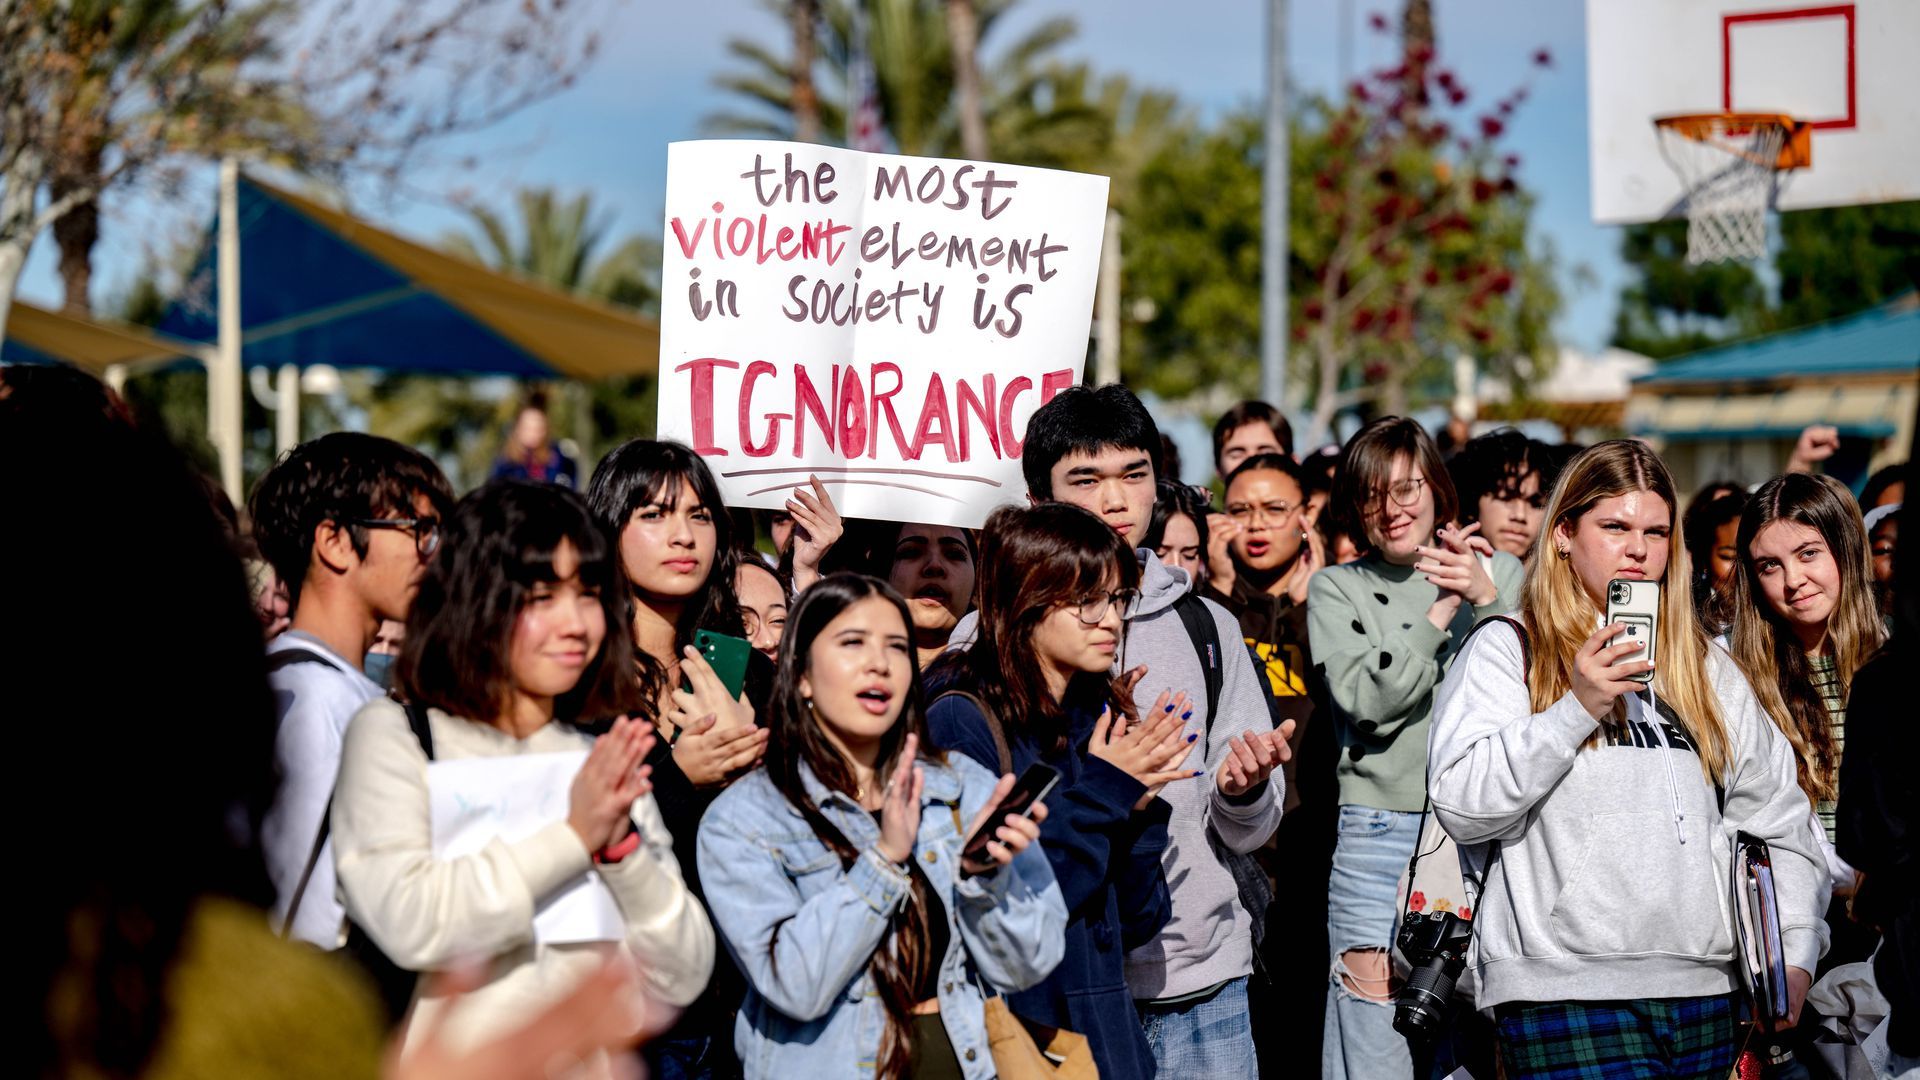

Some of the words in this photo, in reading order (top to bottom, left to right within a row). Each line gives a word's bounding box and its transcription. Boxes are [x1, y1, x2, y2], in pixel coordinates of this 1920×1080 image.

[740, 152, 839, 207] the
[688, 267, 741, 322] in
[782, 267, 945, 334] society
[973, 272, 1034, 339] is
